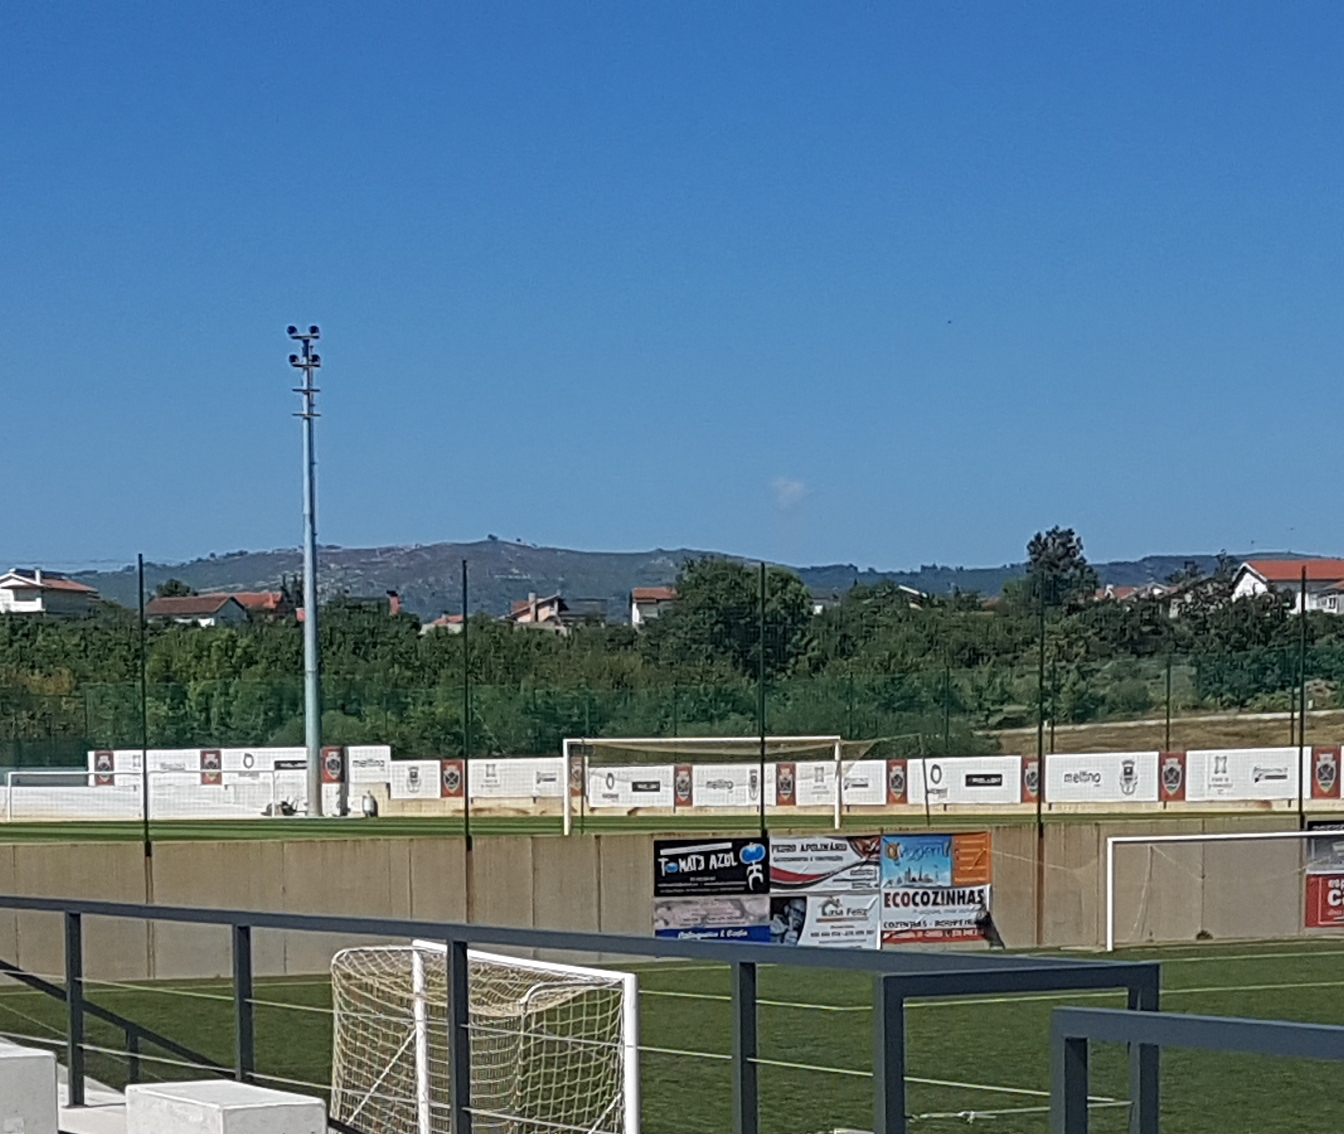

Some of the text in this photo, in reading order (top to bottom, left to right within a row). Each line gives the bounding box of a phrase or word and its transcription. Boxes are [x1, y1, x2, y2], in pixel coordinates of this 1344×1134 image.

[1063, 771, 1102, 784] meltino
[709, 851, 739, 871] AZUL
[883, 888, 985, 909] ECOCOZINHAS
[883, 919, 928, 930] COZINHAS
